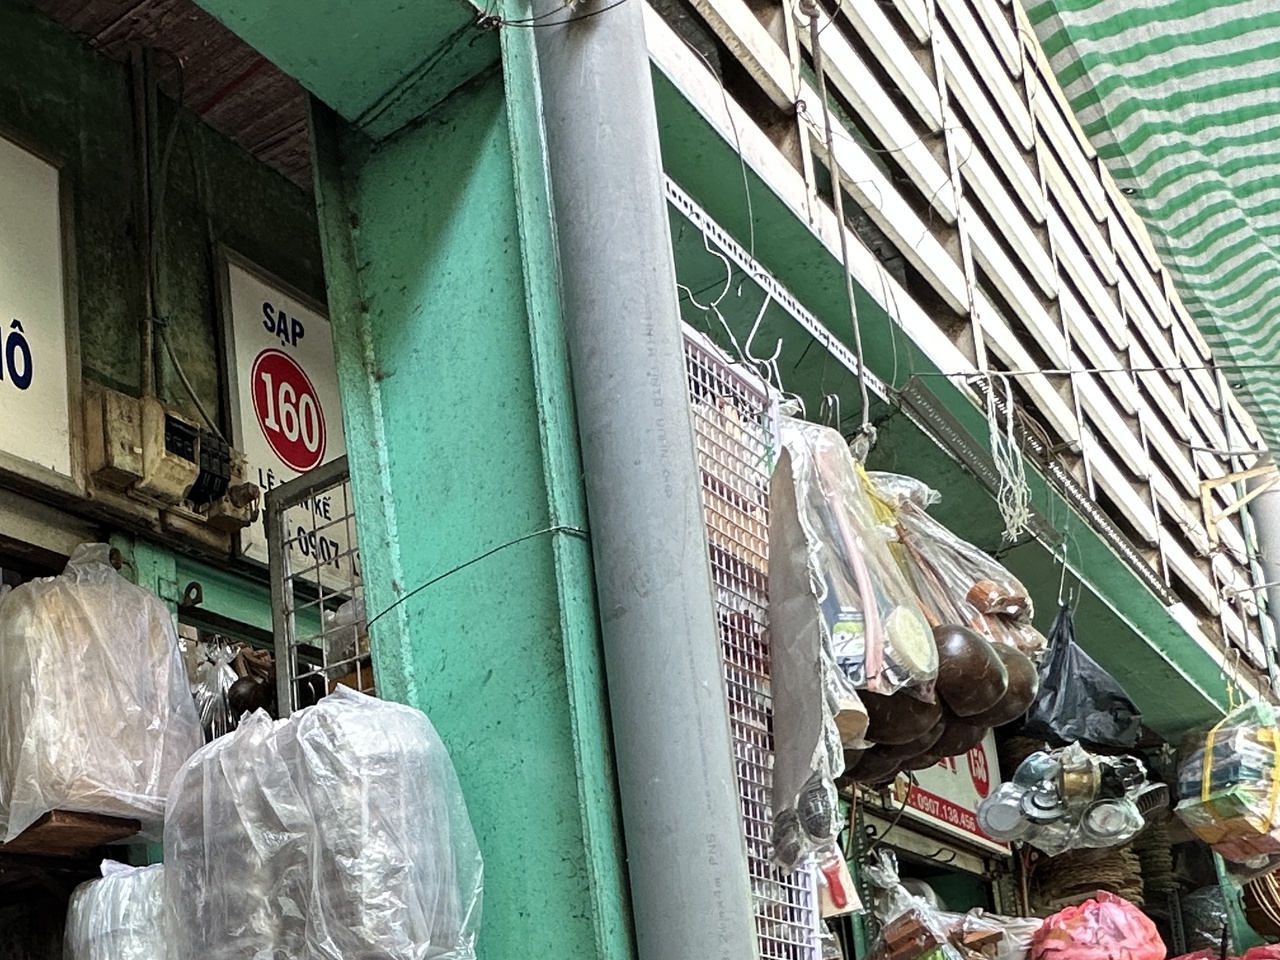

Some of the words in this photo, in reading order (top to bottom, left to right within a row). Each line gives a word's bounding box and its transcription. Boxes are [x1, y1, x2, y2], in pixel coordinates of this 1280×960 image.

[262, 301, 304, 348] SẠP
[261, 371, 320, 452] 160
[297, 526, 340, 569] 0907
